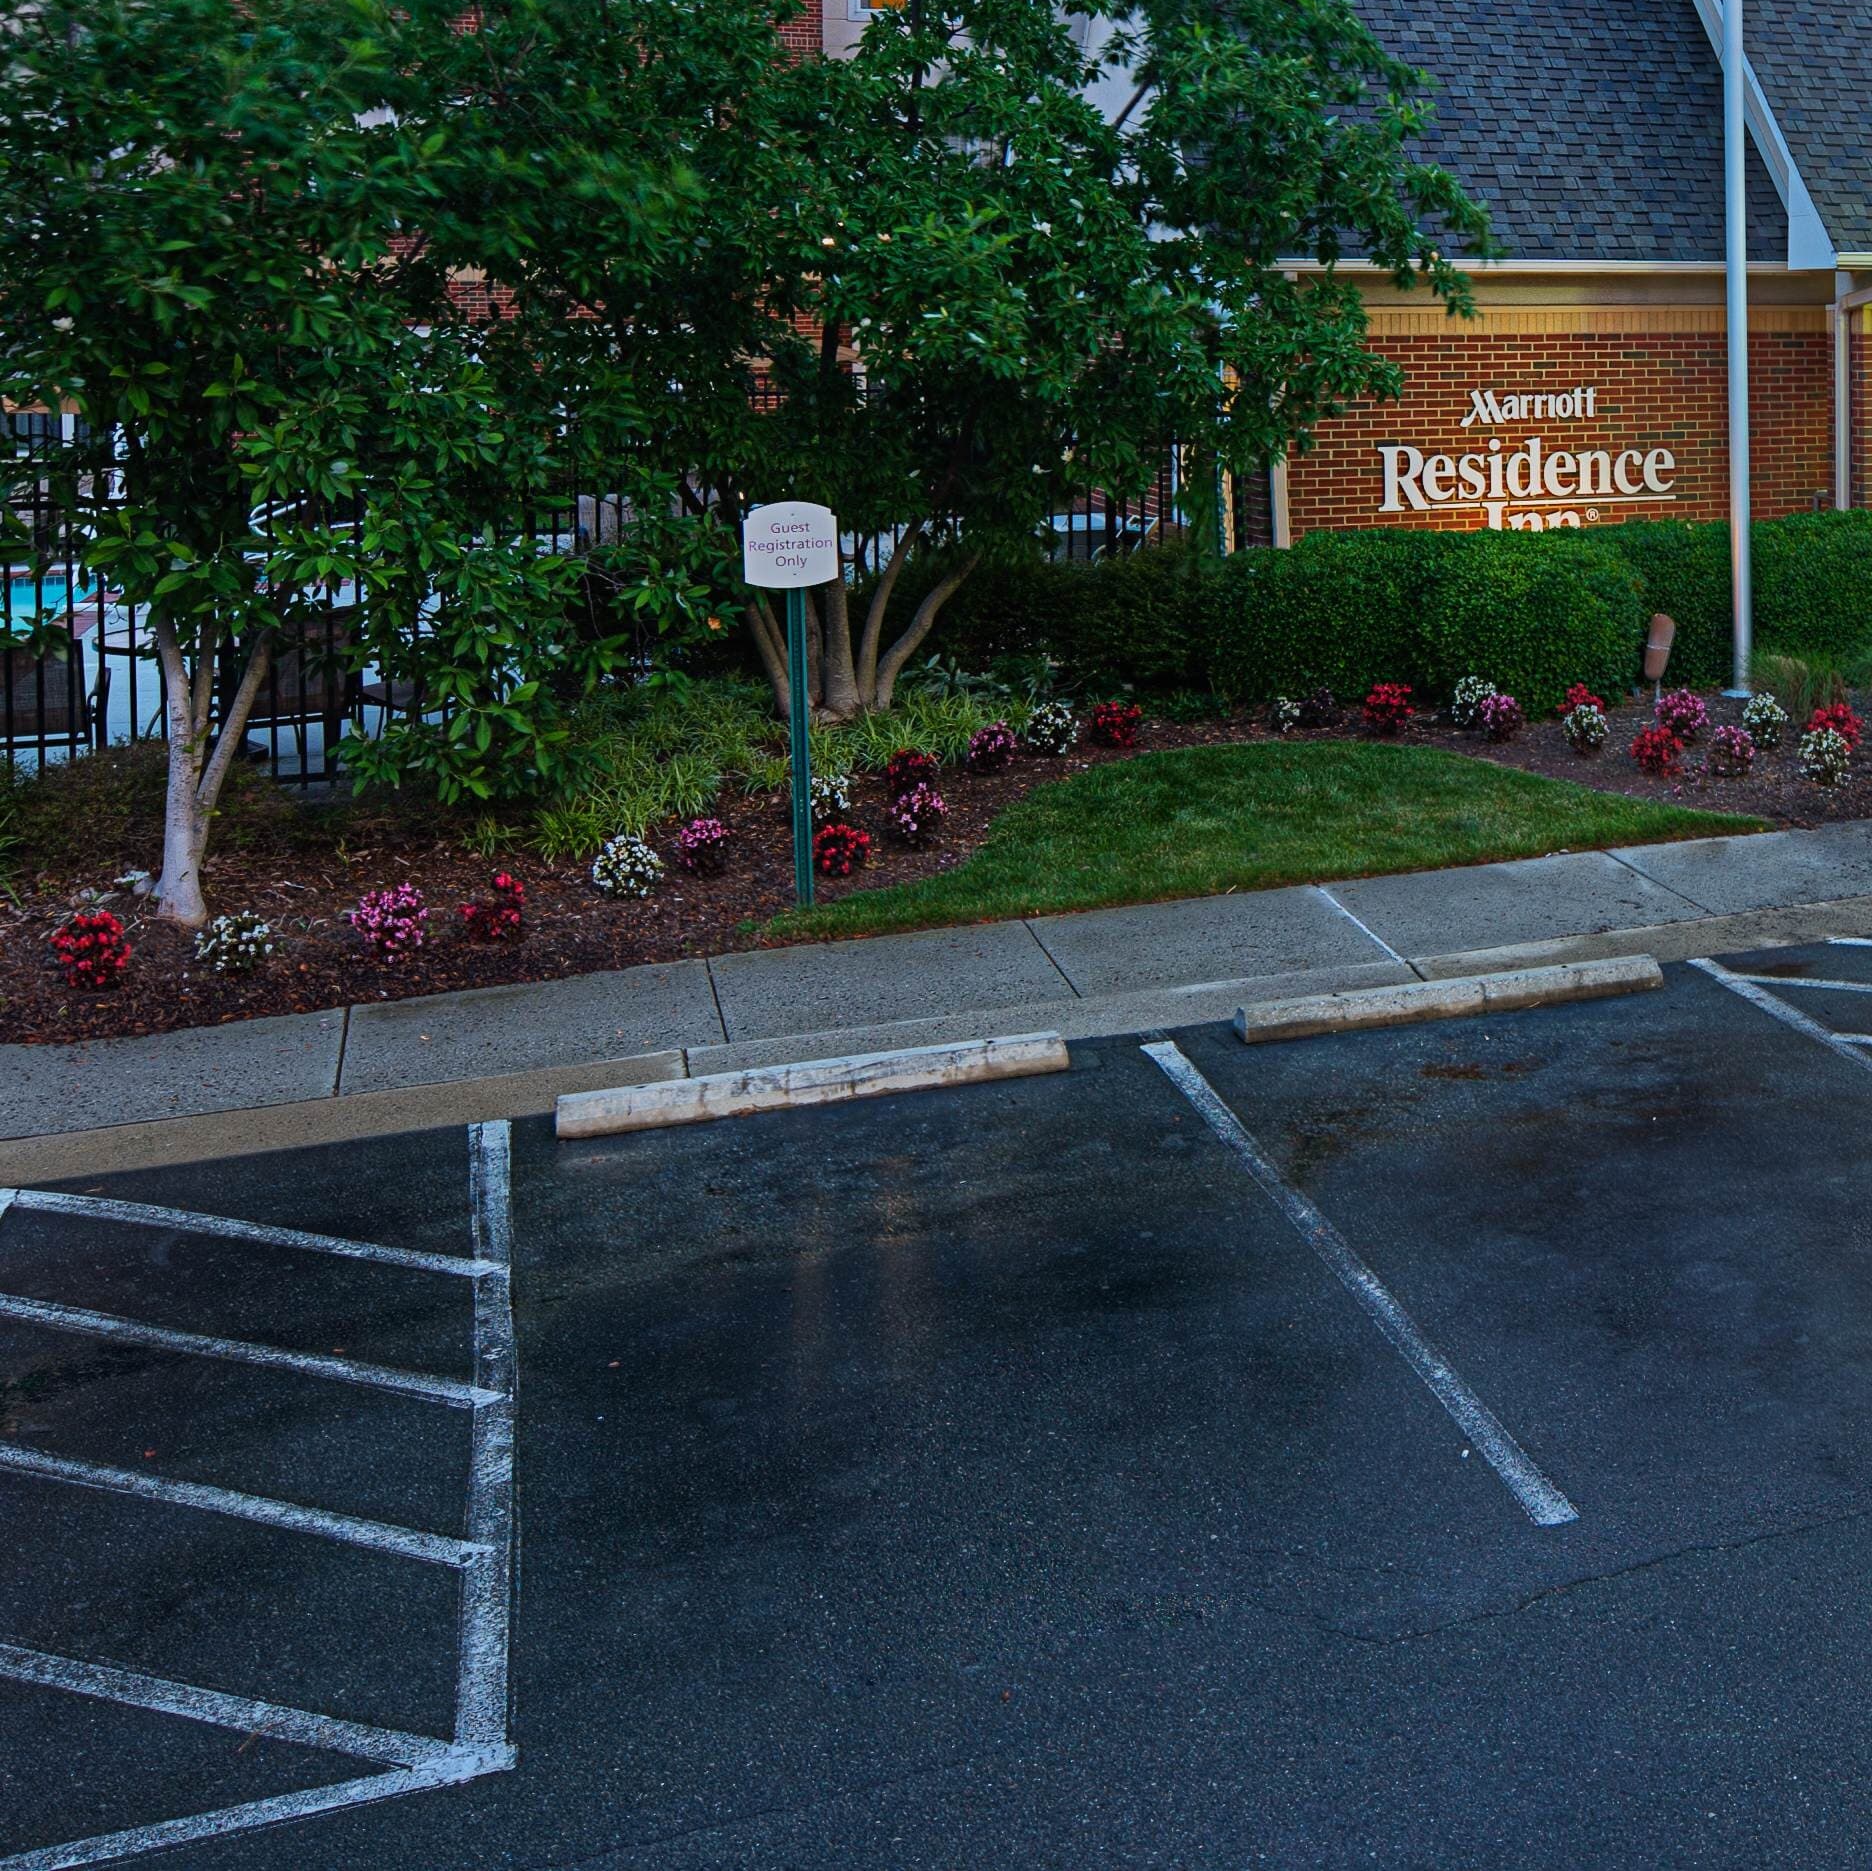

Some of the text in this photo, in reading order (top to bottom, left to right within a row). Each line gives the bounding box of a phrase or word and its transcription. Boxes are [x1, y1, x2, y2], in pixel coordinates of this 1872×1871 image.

[1459, 386, 1597, 428] Marriott
[1377, 437, 1676, 512] Residence
[770, 522, 811, 534] Guest
[748, 537, 833, 553] Registration
[775, 555, 808, 568] Only
